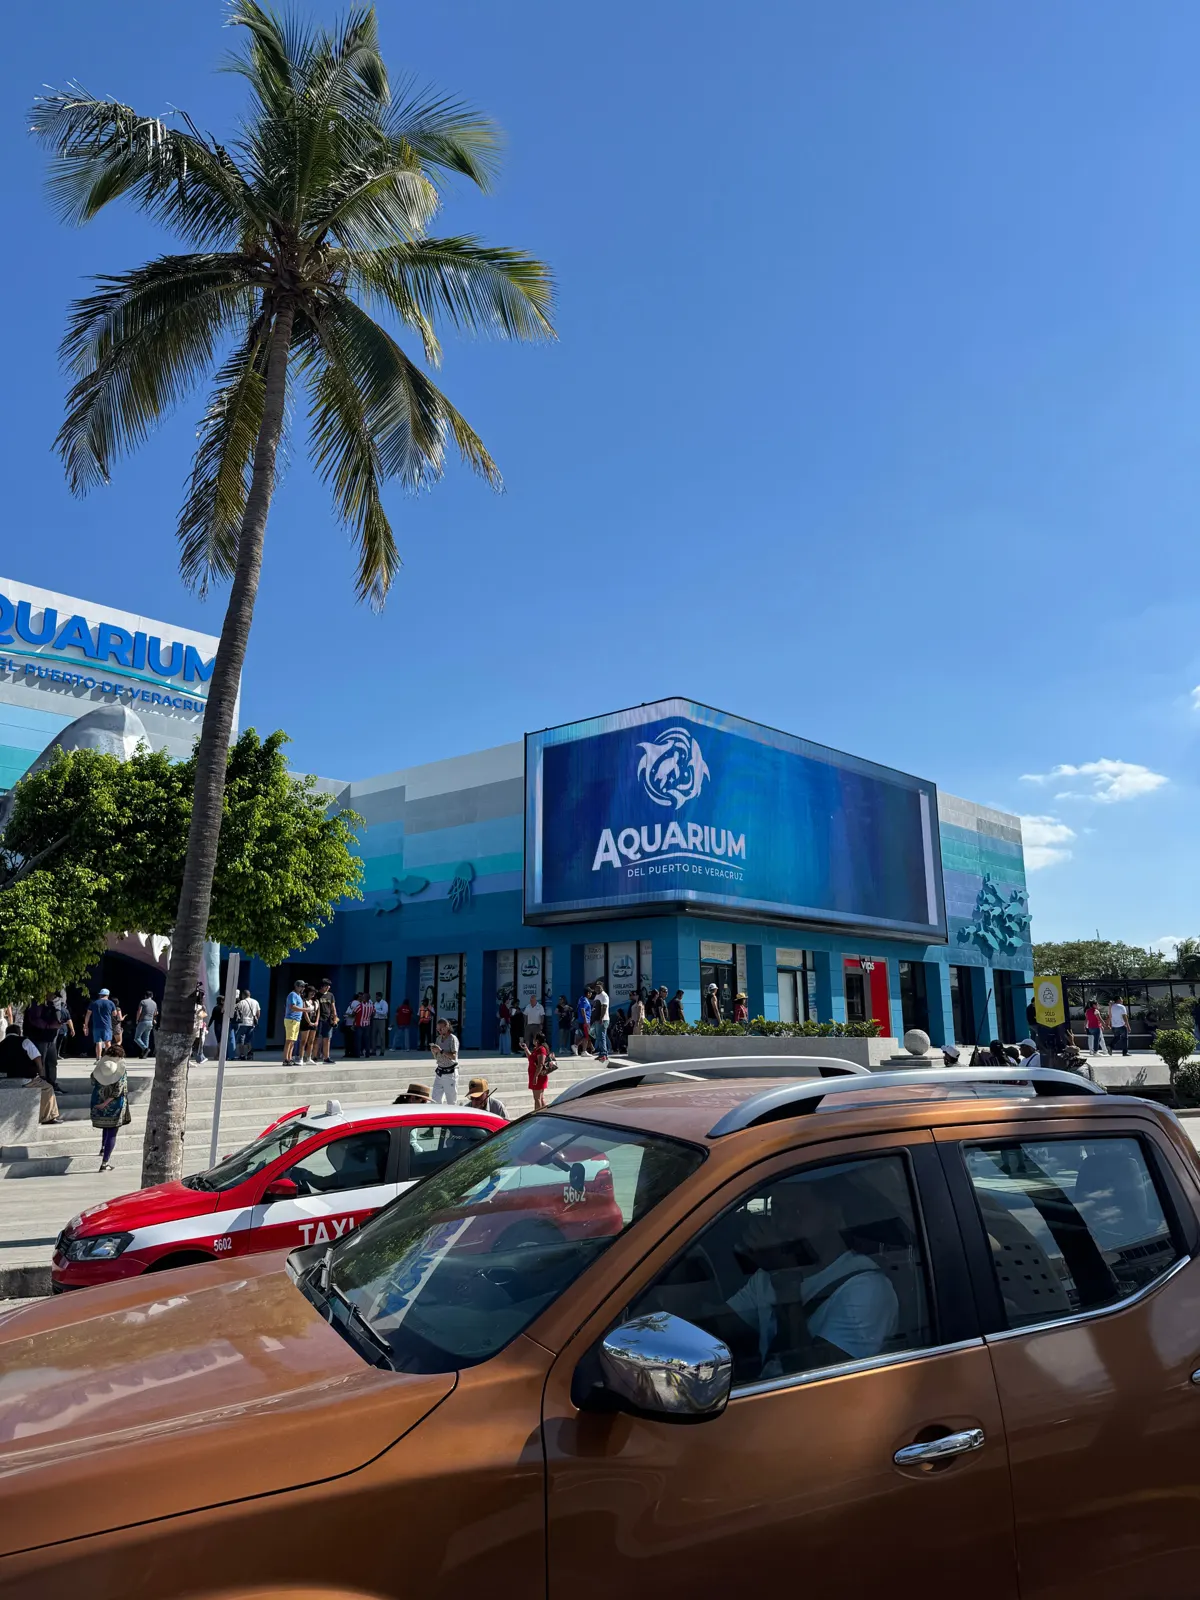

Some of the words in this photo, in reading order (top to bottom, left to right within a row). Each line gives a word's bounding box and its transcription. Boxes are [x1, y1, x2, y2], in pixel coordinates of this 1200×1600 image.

[25, 663, 97, 689] PUERTO
[101, 680, 124, 697] DE
[592, 821, 747, 871] AQUARIUM
[627, 868, 646, 878] DEL
[648, 863, 690, 875] PUERTO
[692, 866, 703, 875] DE
[704, 866, 744, 881] VERACRUZ
[860, 958, 875, 974] vips
[213, 1237, 232, 1251] 5602
